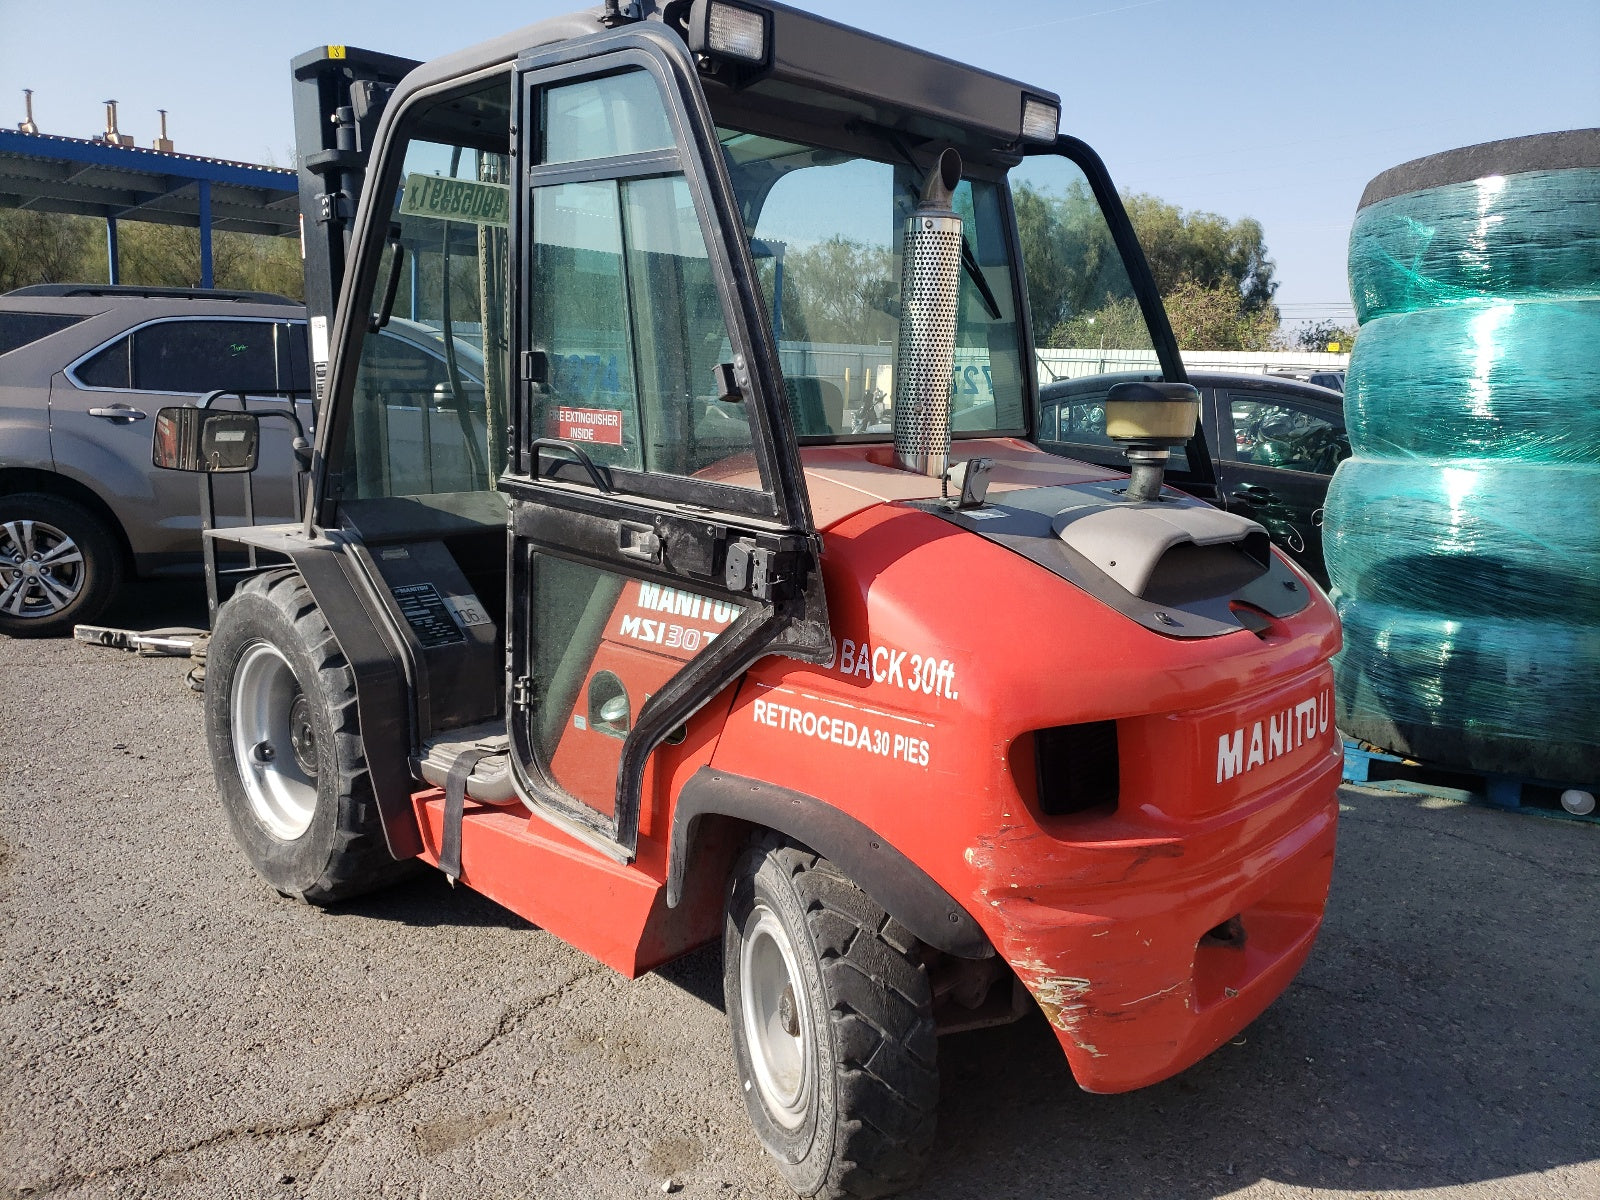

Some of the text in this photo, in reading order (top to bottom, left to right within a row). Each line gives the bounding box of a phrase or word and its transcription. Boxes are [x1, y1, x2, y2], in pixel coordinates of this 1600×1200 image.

[565, 411, 618, 427] EXTINGUISHER
[570, 427, 594, 440] INSIDE
[454, 608, 480, 624] 106
[840, 638, 907, 688] BACK
[907, 654, 959, 700] 30ft.
[1216, 688, 1330, 784] MANITOU
[893, 734, 930, 766] PIES
